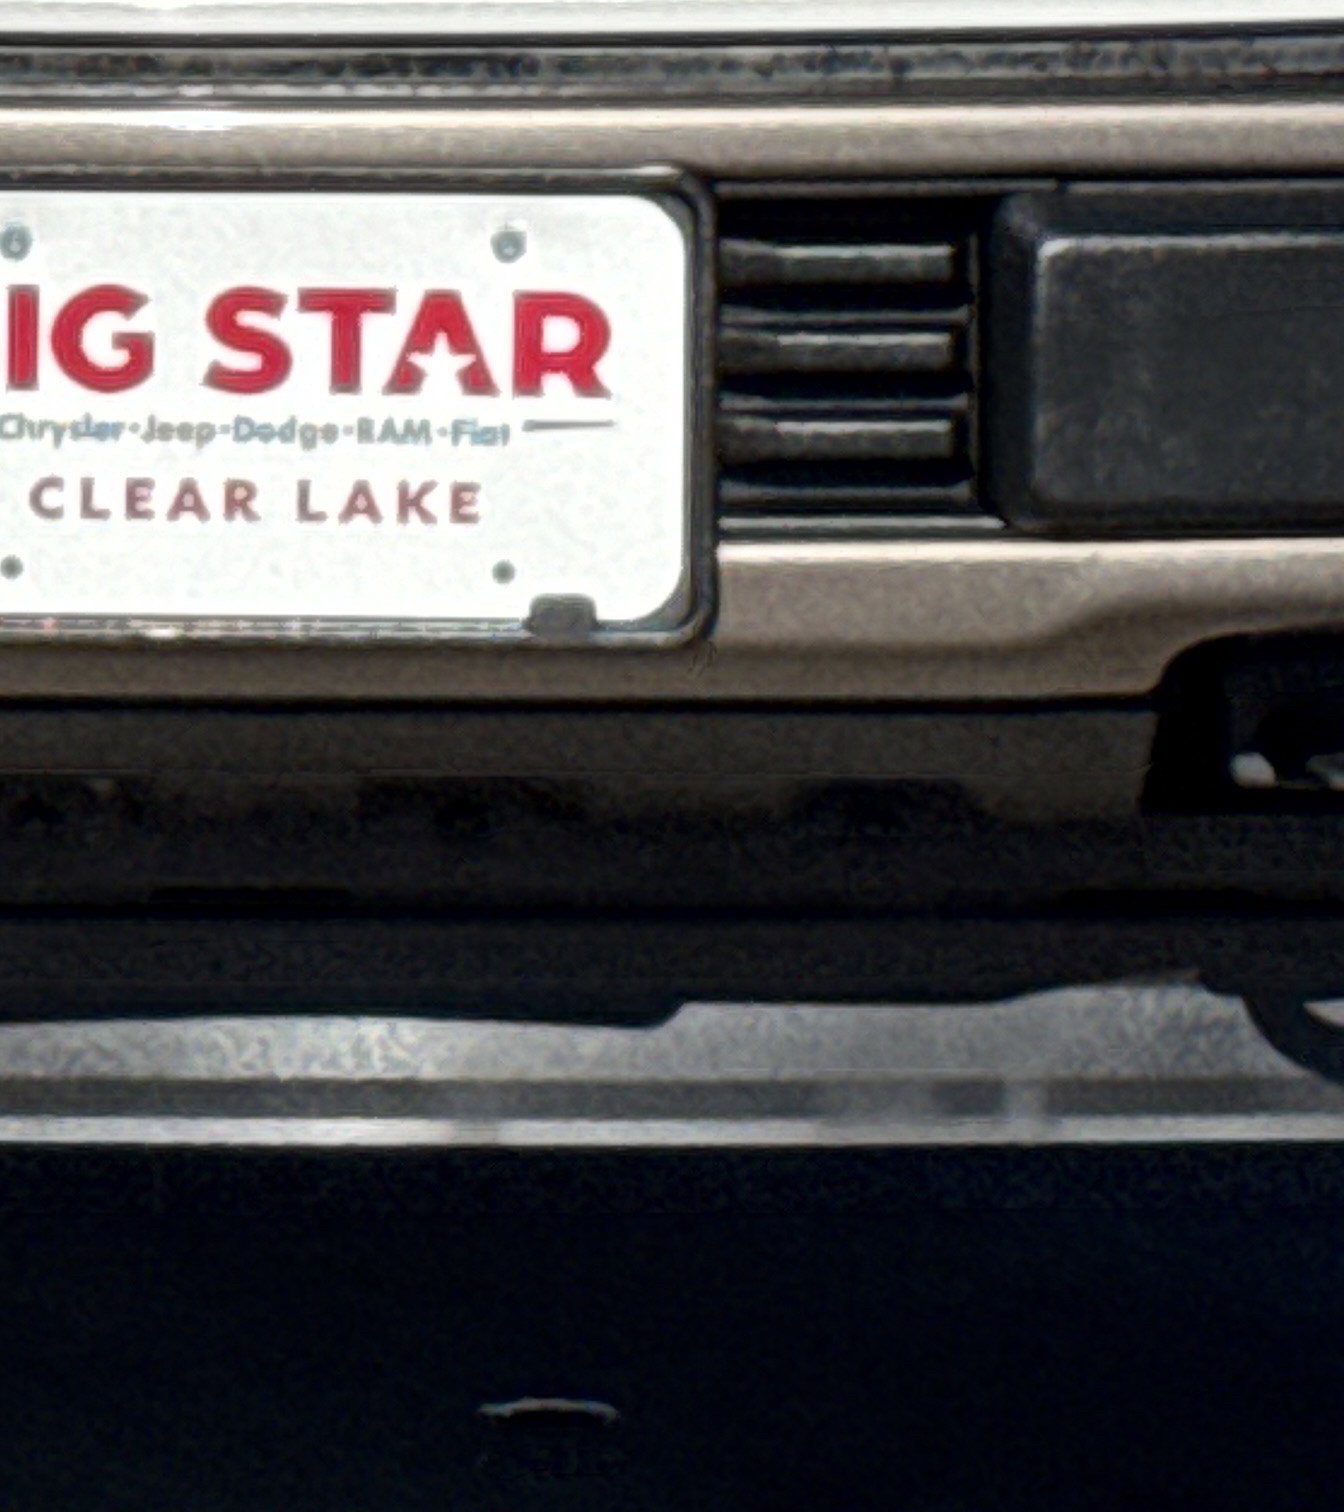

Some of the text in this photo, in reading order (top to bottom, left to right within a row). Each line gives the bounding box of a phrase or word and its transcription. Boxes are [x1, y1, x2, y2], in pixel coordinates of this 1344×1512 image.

[202, 285, 612, 398] STAR
[140, 414, 216, 450] Jeep
[232, 414, 339, 451] Dodge
[357, 416, 432, 445] RAM
[28, 474, 482, 524] CLEAR LAKE
